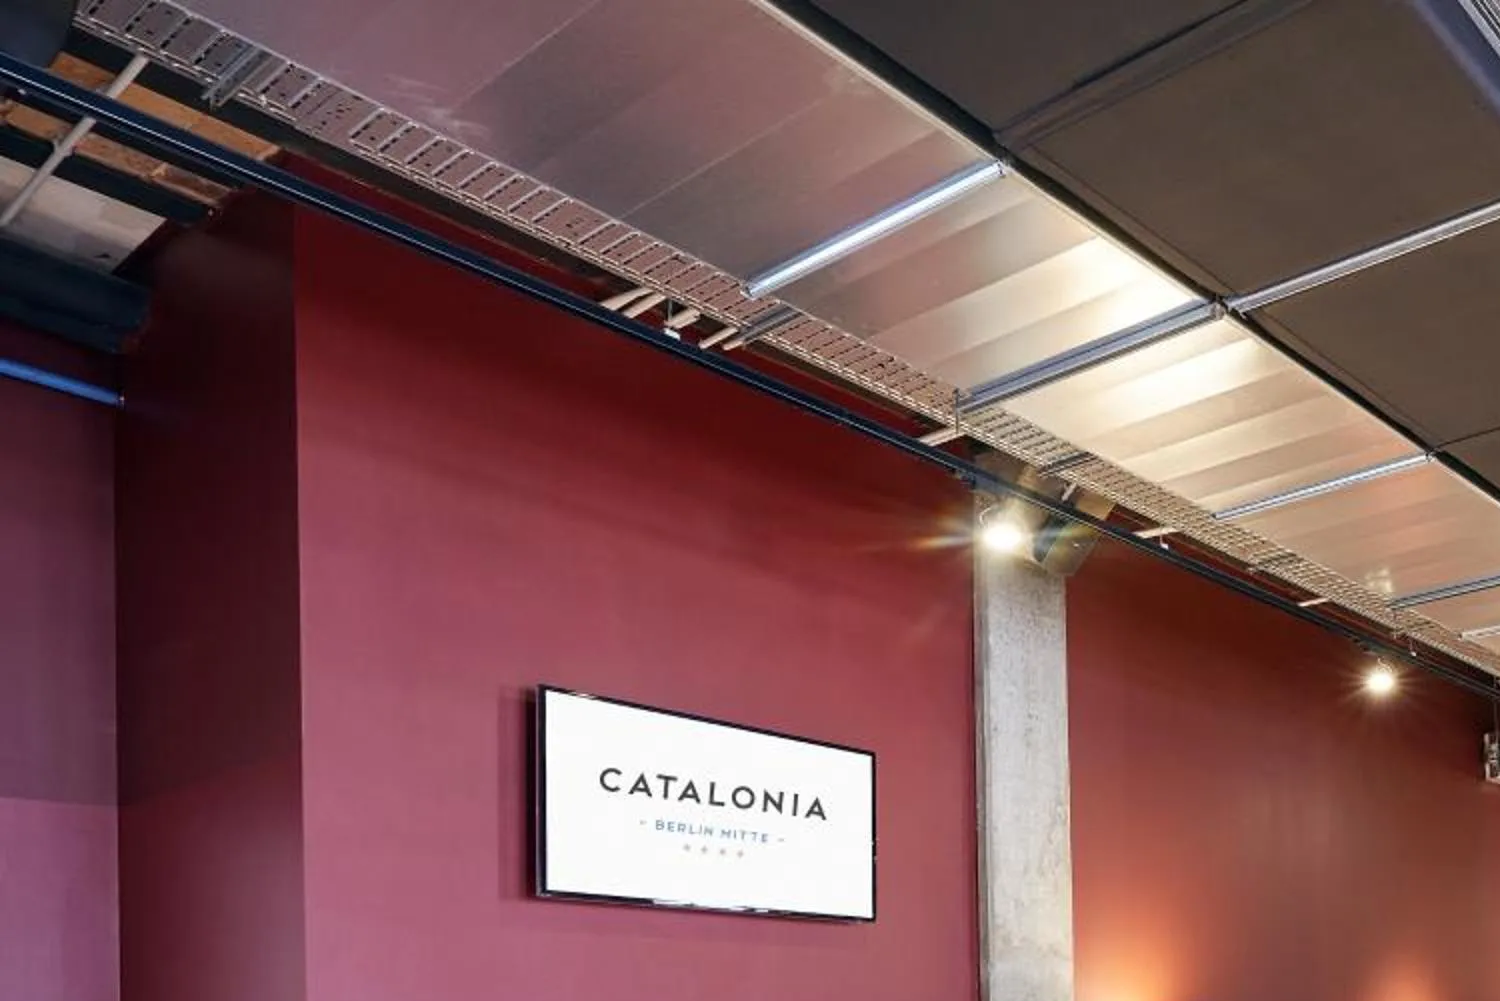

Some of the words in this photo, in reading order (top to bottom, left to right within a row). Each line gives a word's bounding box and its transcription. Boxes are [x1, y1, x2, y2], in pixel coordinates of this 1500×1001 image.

[599, 767, 827, 821] CATALONIA
[655, 819, 714, 837] BERLIN
[720, 828, 769, 844] MITTE
